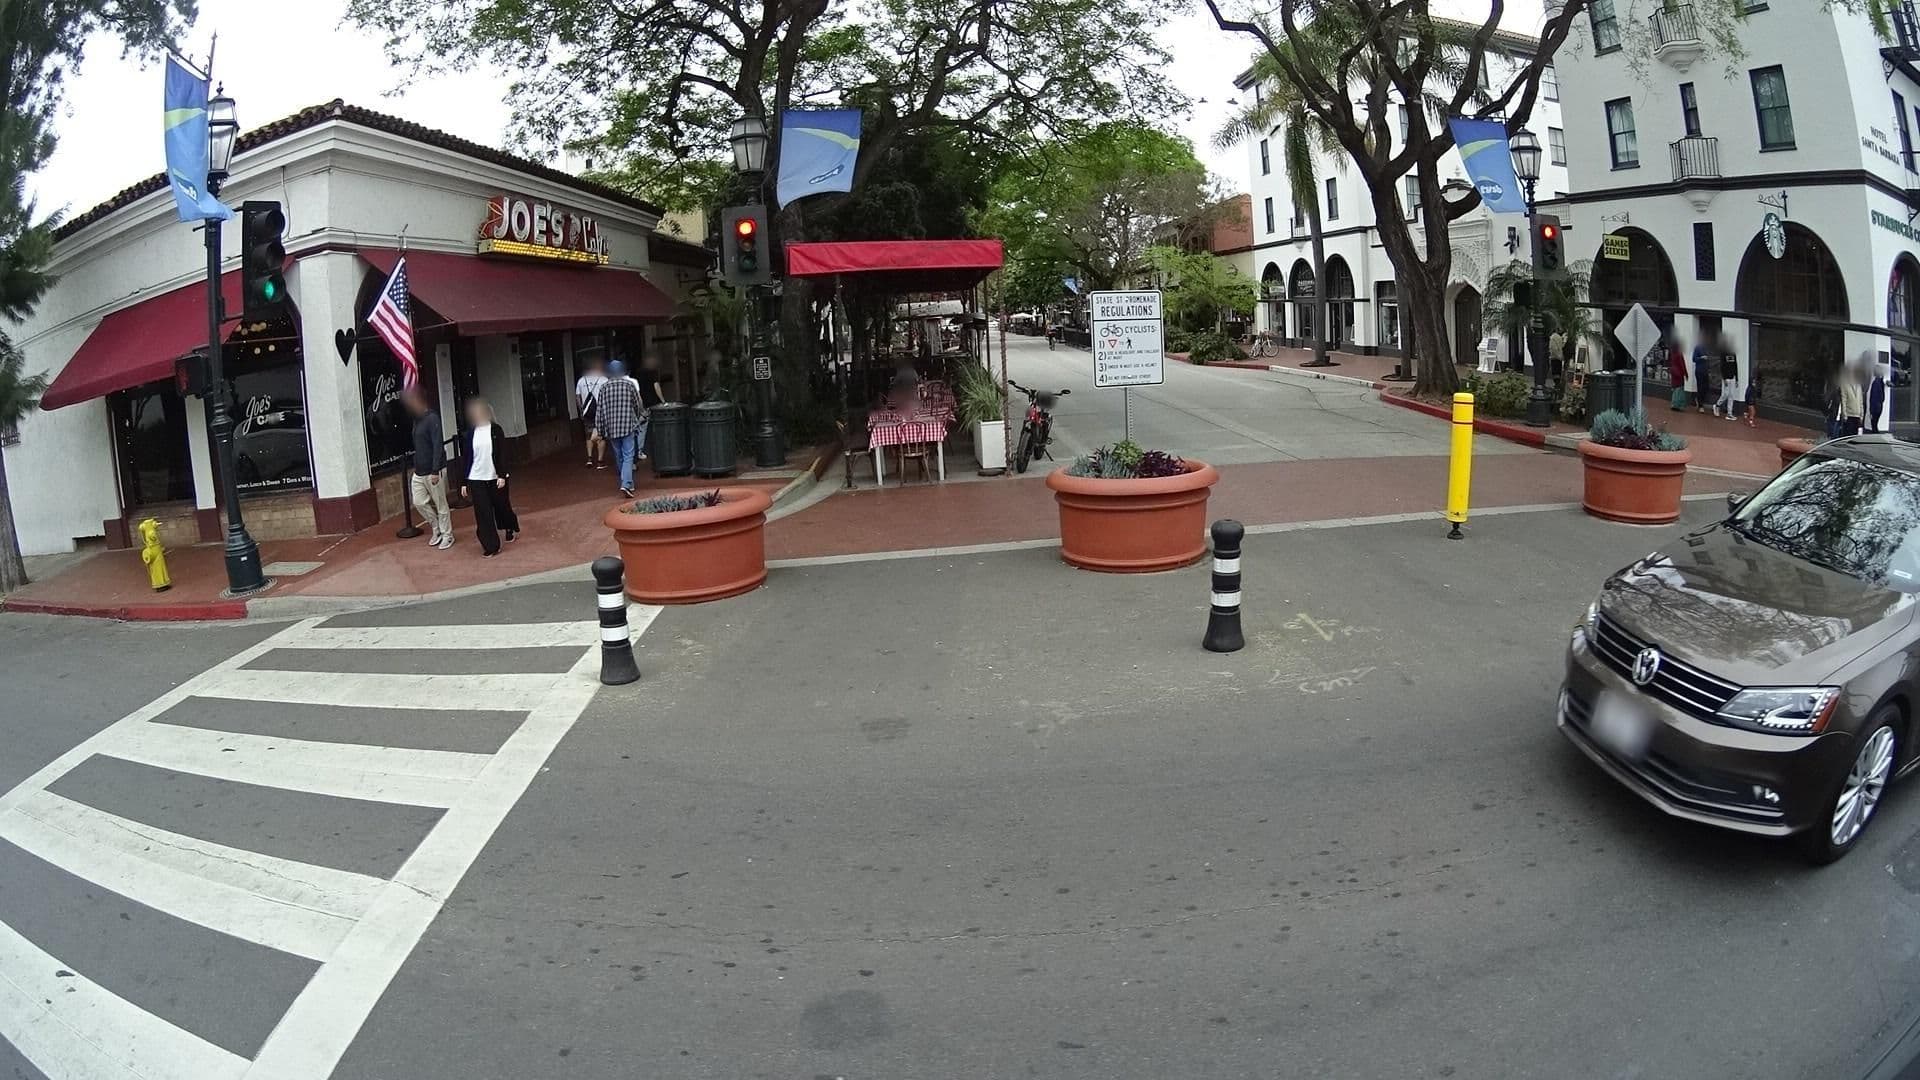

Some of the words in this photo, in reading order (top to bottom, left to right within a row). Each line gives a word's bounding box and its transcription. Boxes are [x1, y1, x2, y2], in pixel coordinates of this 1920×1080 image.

[1870, 126, 1888, 144] HOTEL
[1861, 136, 1879, 153] SANTA
[1879, 146, 1900, 165] BARBARA
[493, 196, 564, 247] JOE'S
[1871, 209, 1914, 241] STARBUCKS
[1096, 296, 1113, 304] STATE
[1116, 296, 1123, 304] ST
[1101, 305, 1153, 317] REGULATIONS
[243, 394, 271, 436] Joe's
